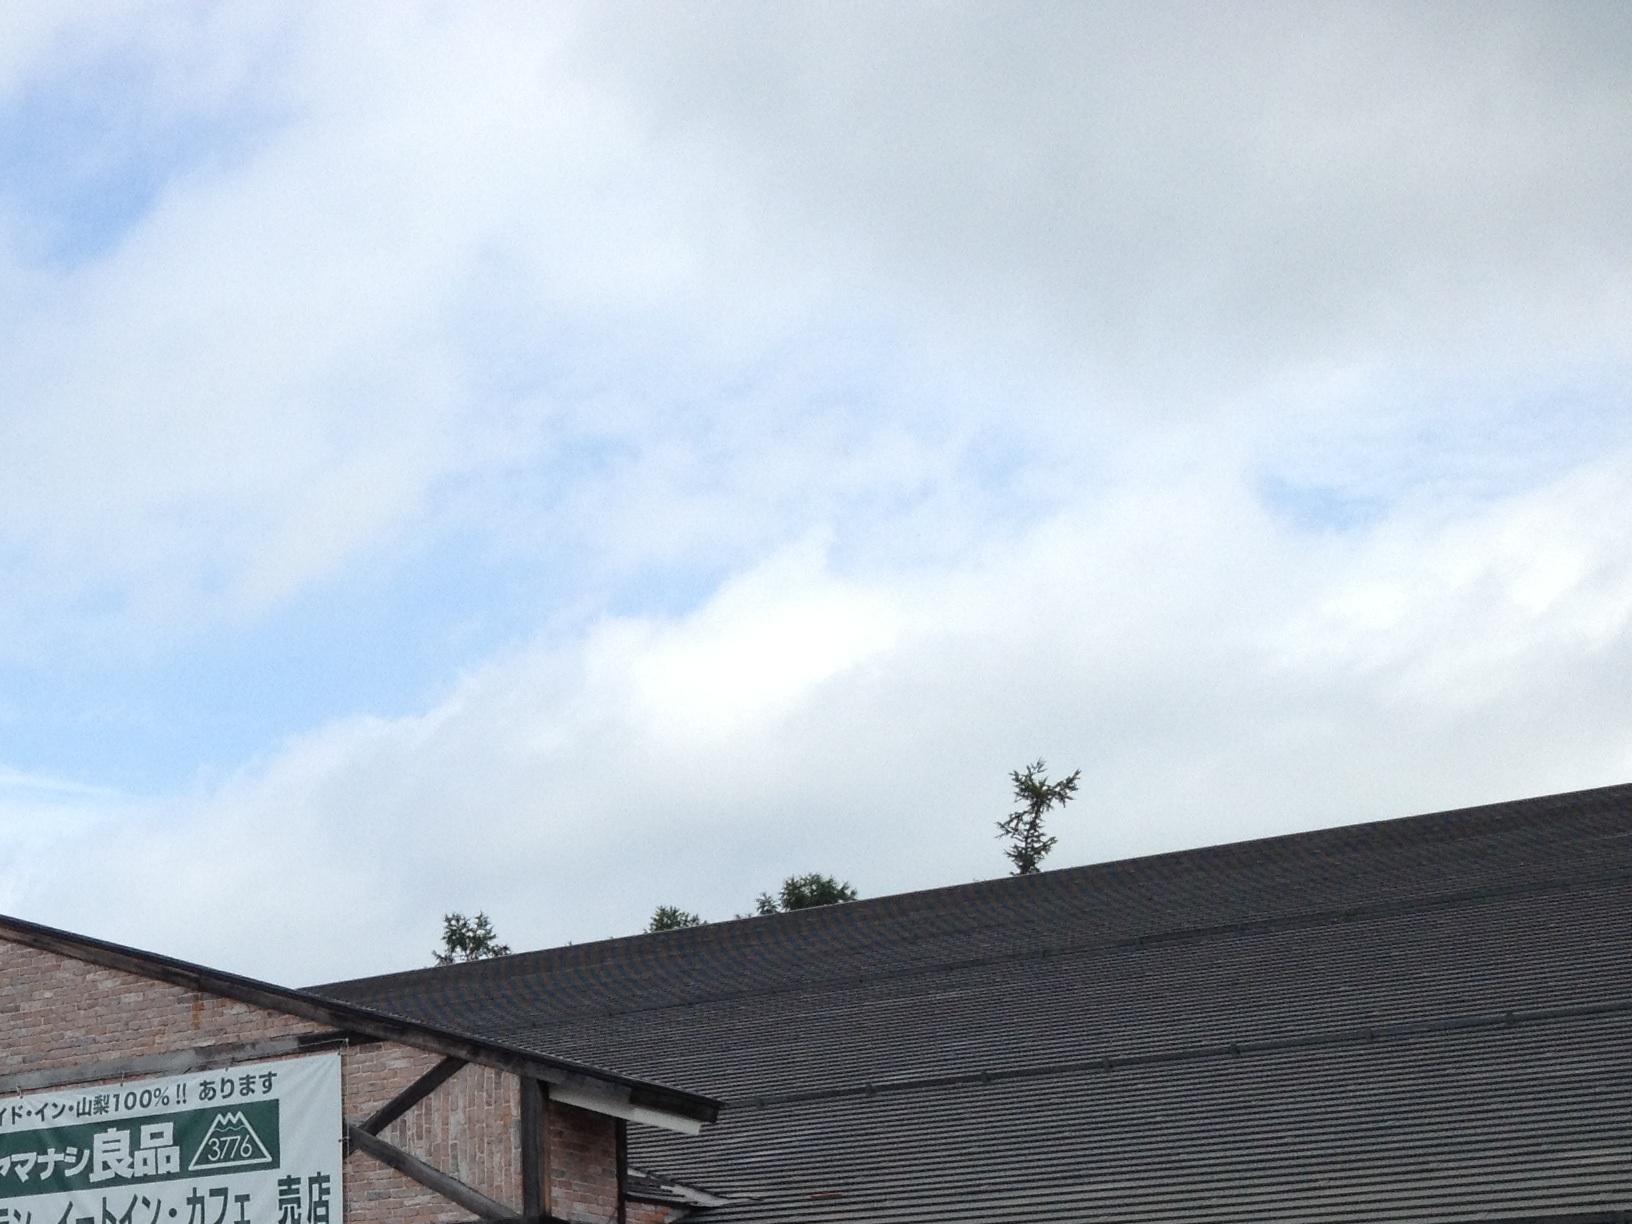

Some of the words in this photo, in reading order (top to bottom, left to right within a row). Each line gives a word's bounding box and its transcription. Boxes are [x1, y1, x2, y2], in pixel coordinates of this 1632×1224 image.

[199, 1071, 278, 1102] あります
[207, 1131, 254, 1162] 3776
